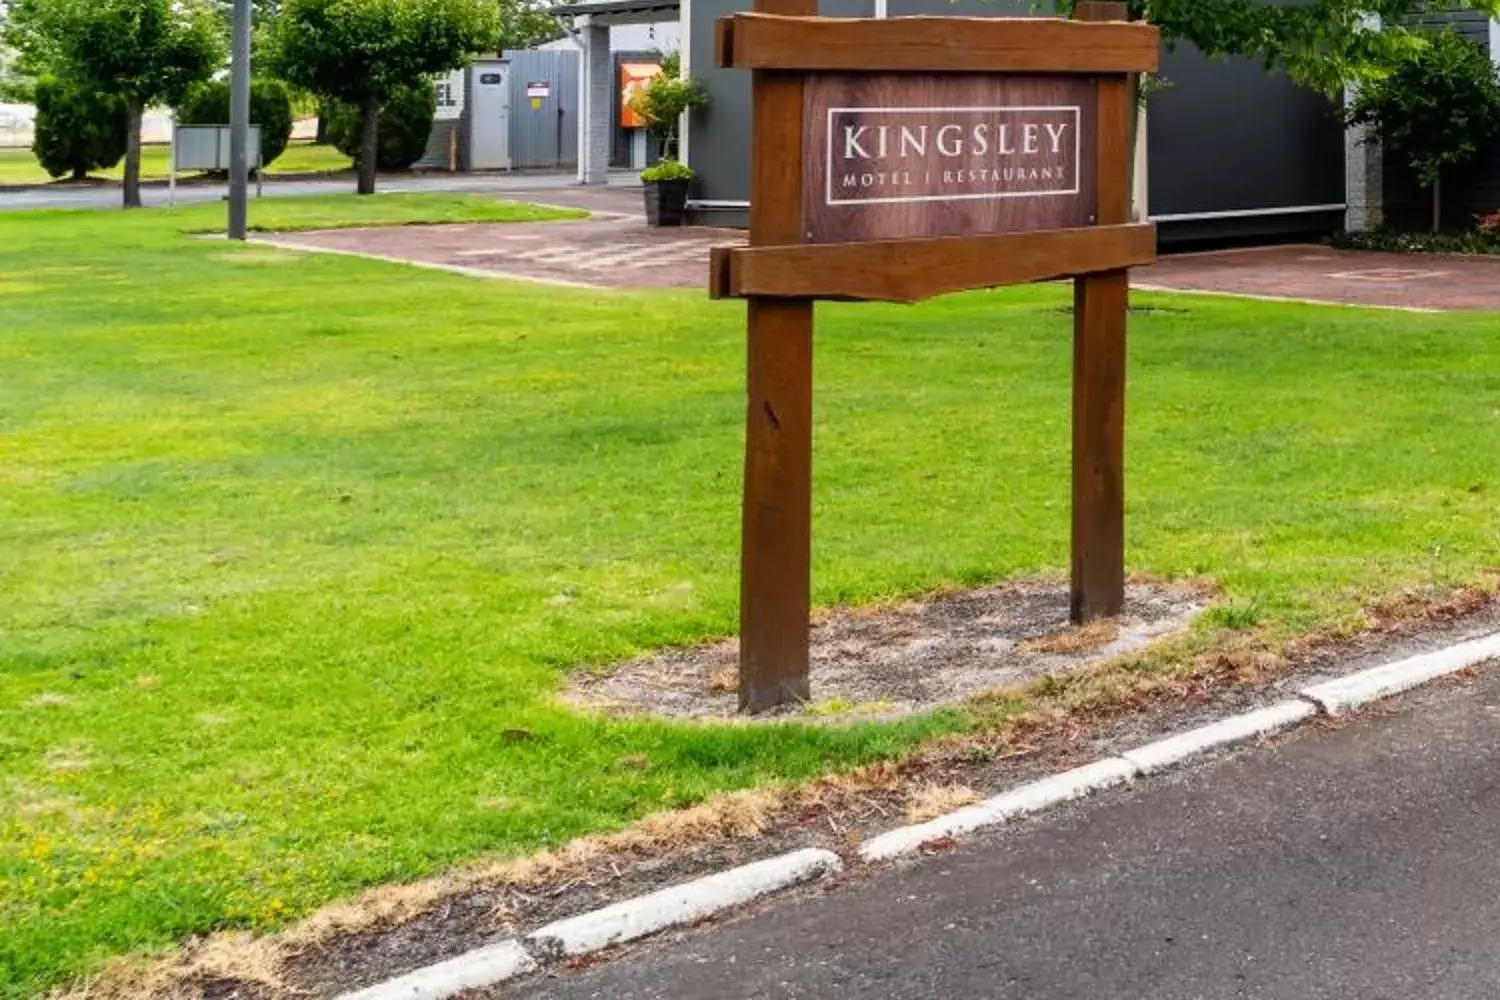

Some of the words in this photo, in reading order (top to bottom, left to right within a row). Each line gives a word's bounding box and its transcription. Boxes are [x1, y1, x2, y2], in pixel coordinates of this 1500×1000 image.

[843, 123, 1069, 159] KINGSLEY
[842, 170, 913, 188] MOTEL
[943, 166, 1067, 184] RESTAURANT
